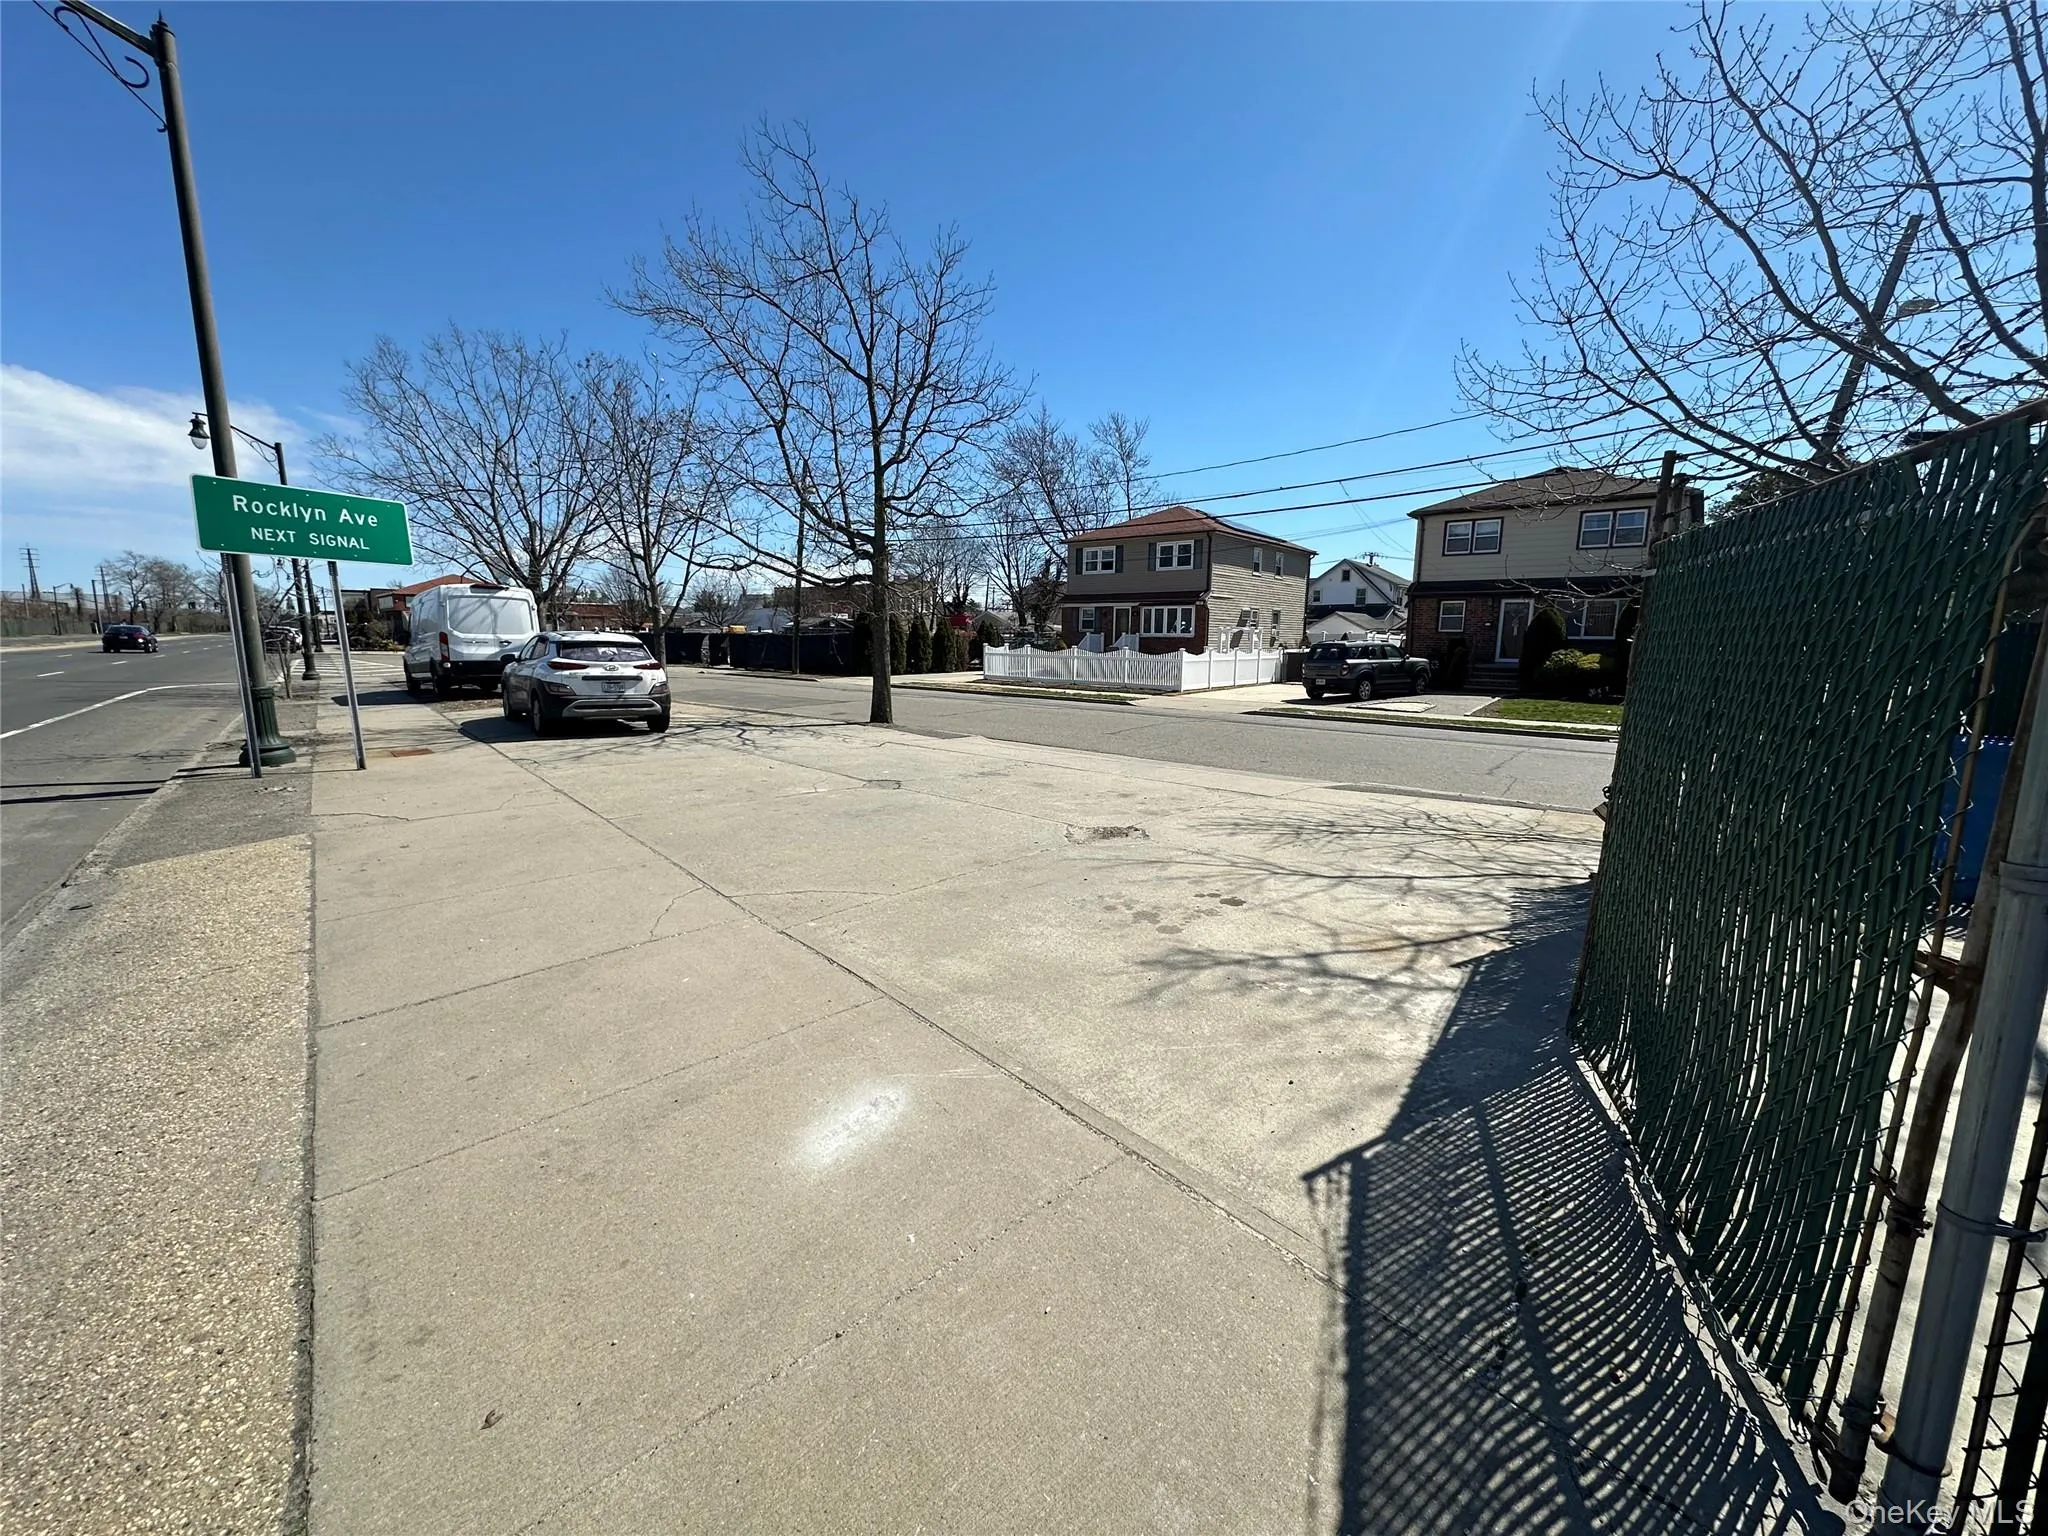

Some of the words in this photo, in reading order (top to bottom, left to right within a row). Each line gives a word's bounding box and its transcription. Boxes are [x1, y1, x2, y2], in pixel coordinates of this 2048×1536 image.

[232, 494, 327, 523] Rocklyn
[339, 508, 378, 527] Ave
[251, 527, 296, 543] NEXT
[309, 533, 370, 550] SIGNAL
